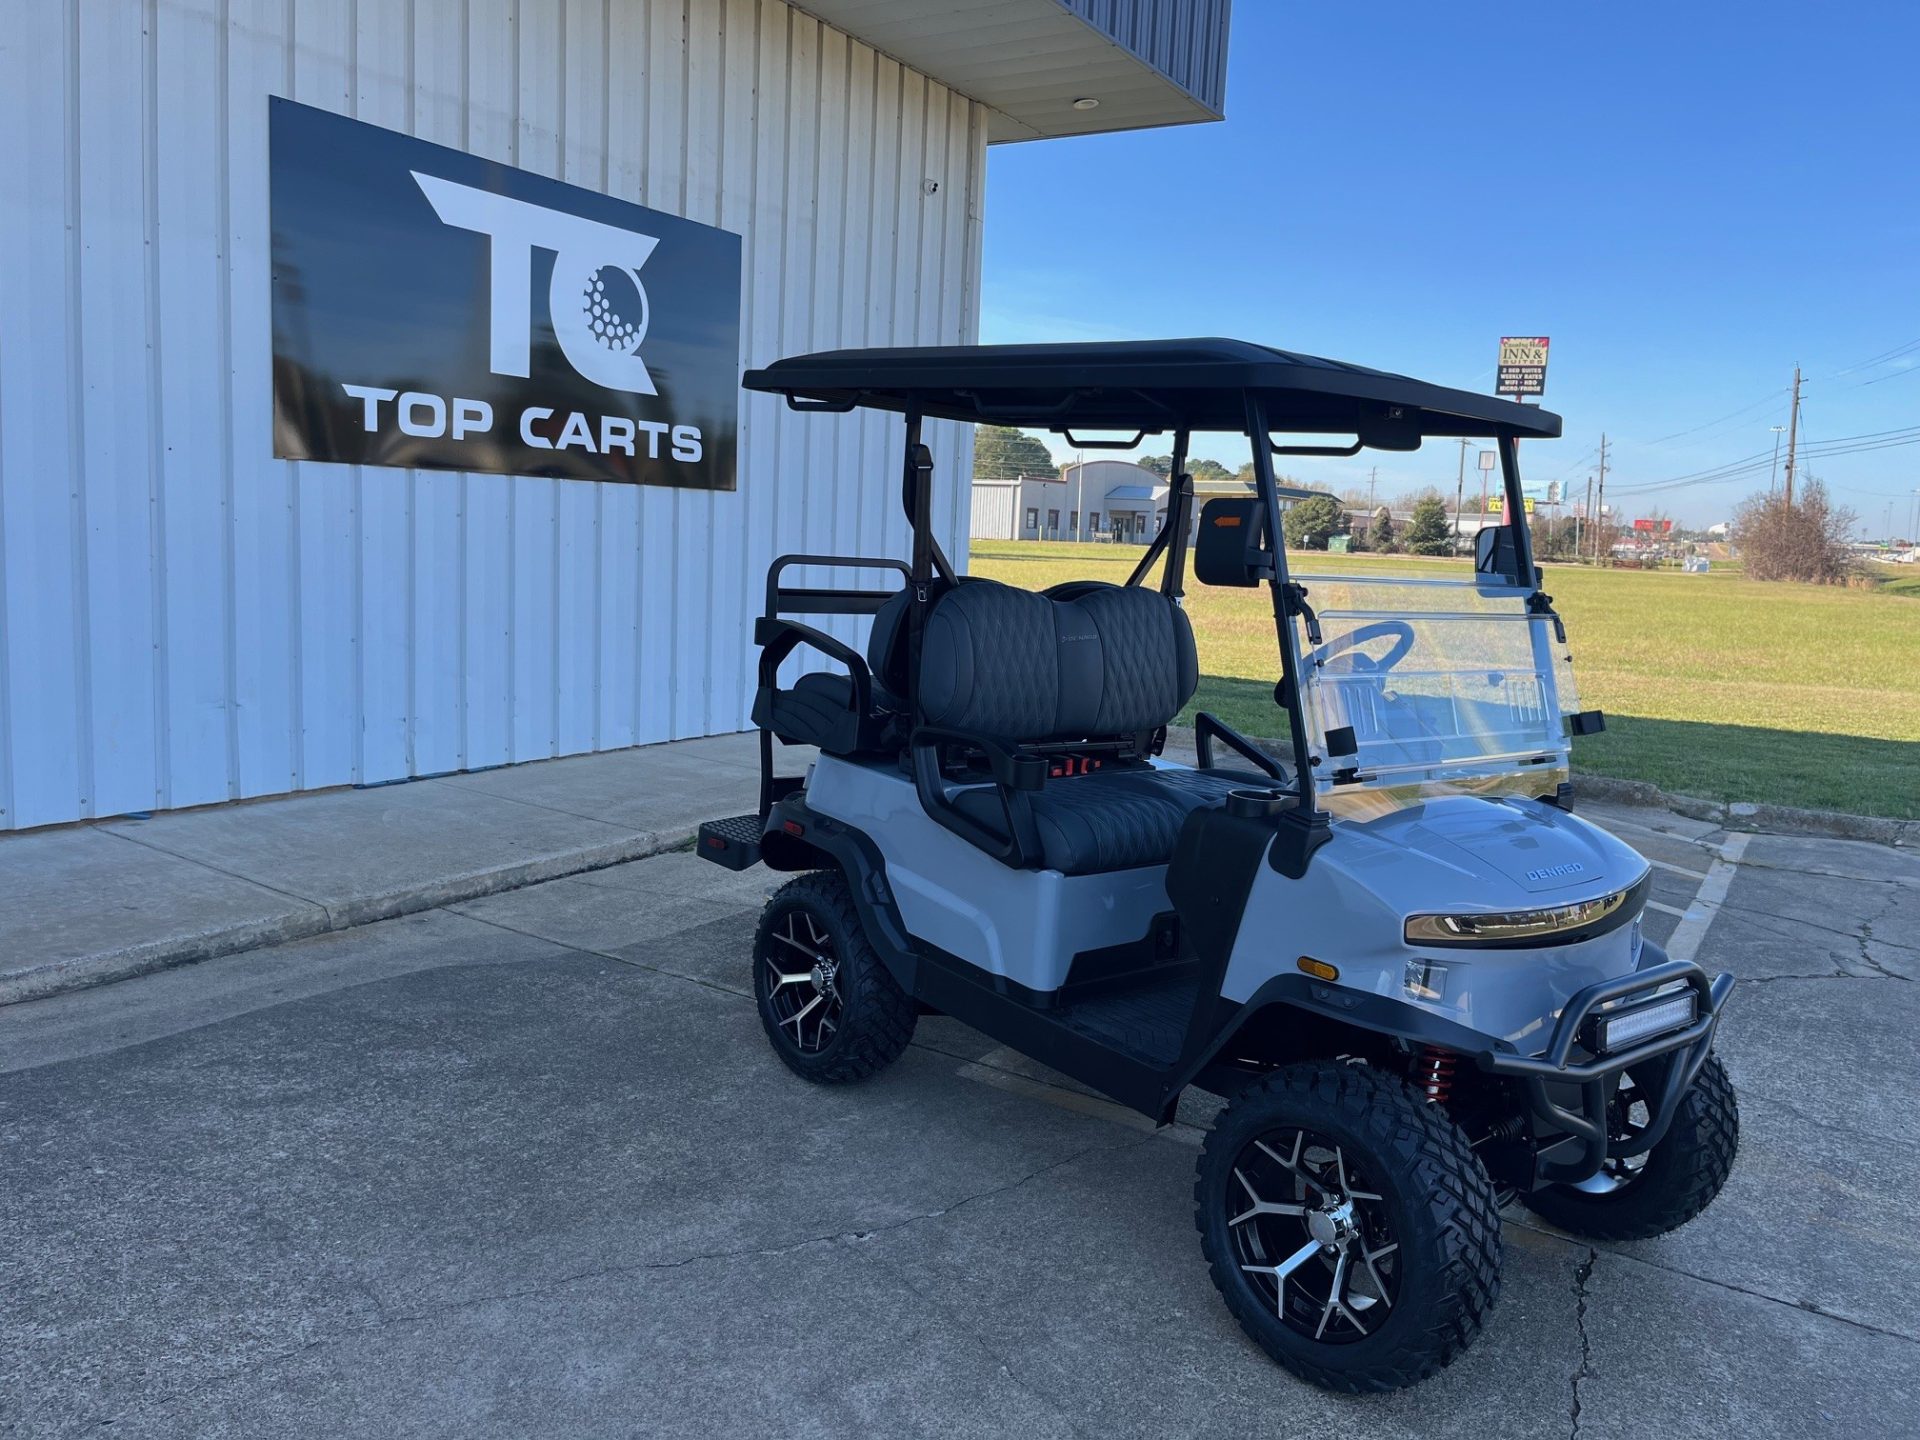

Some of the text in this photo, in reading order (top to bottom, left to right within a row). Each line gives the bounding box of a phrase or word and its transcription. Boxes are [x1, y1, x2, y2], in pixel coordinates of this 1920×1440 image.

[1503, 348, 1542, 359] INN &
[342, 384, 704, 463] TOP CARTS
[1525, 863, 1584, 880] DENAGO
